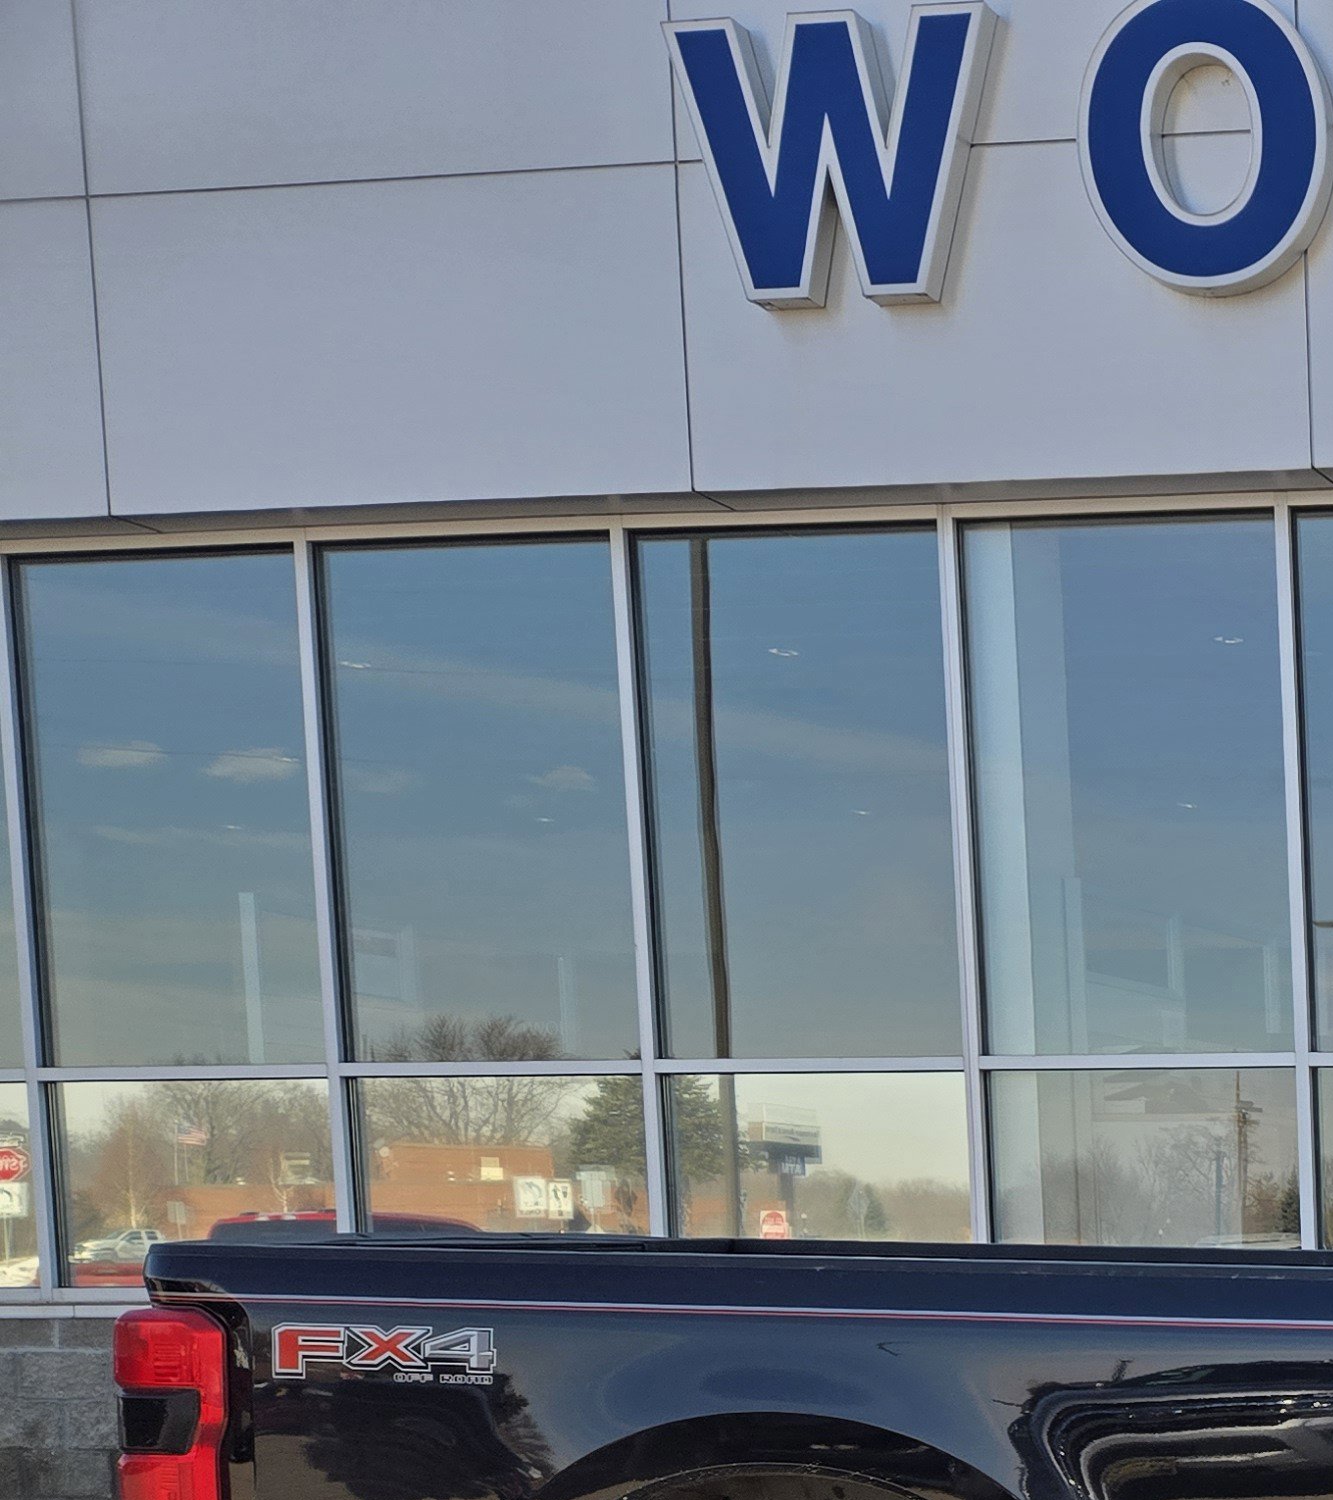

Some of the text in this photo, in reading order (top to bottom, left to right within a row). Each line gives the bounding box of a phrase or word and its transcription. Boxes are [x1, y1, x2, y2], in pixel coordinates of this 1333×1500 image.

[271, 1322, 497, 1379] FX4
[393, 1373, 494, 1385] OFF ROAD
